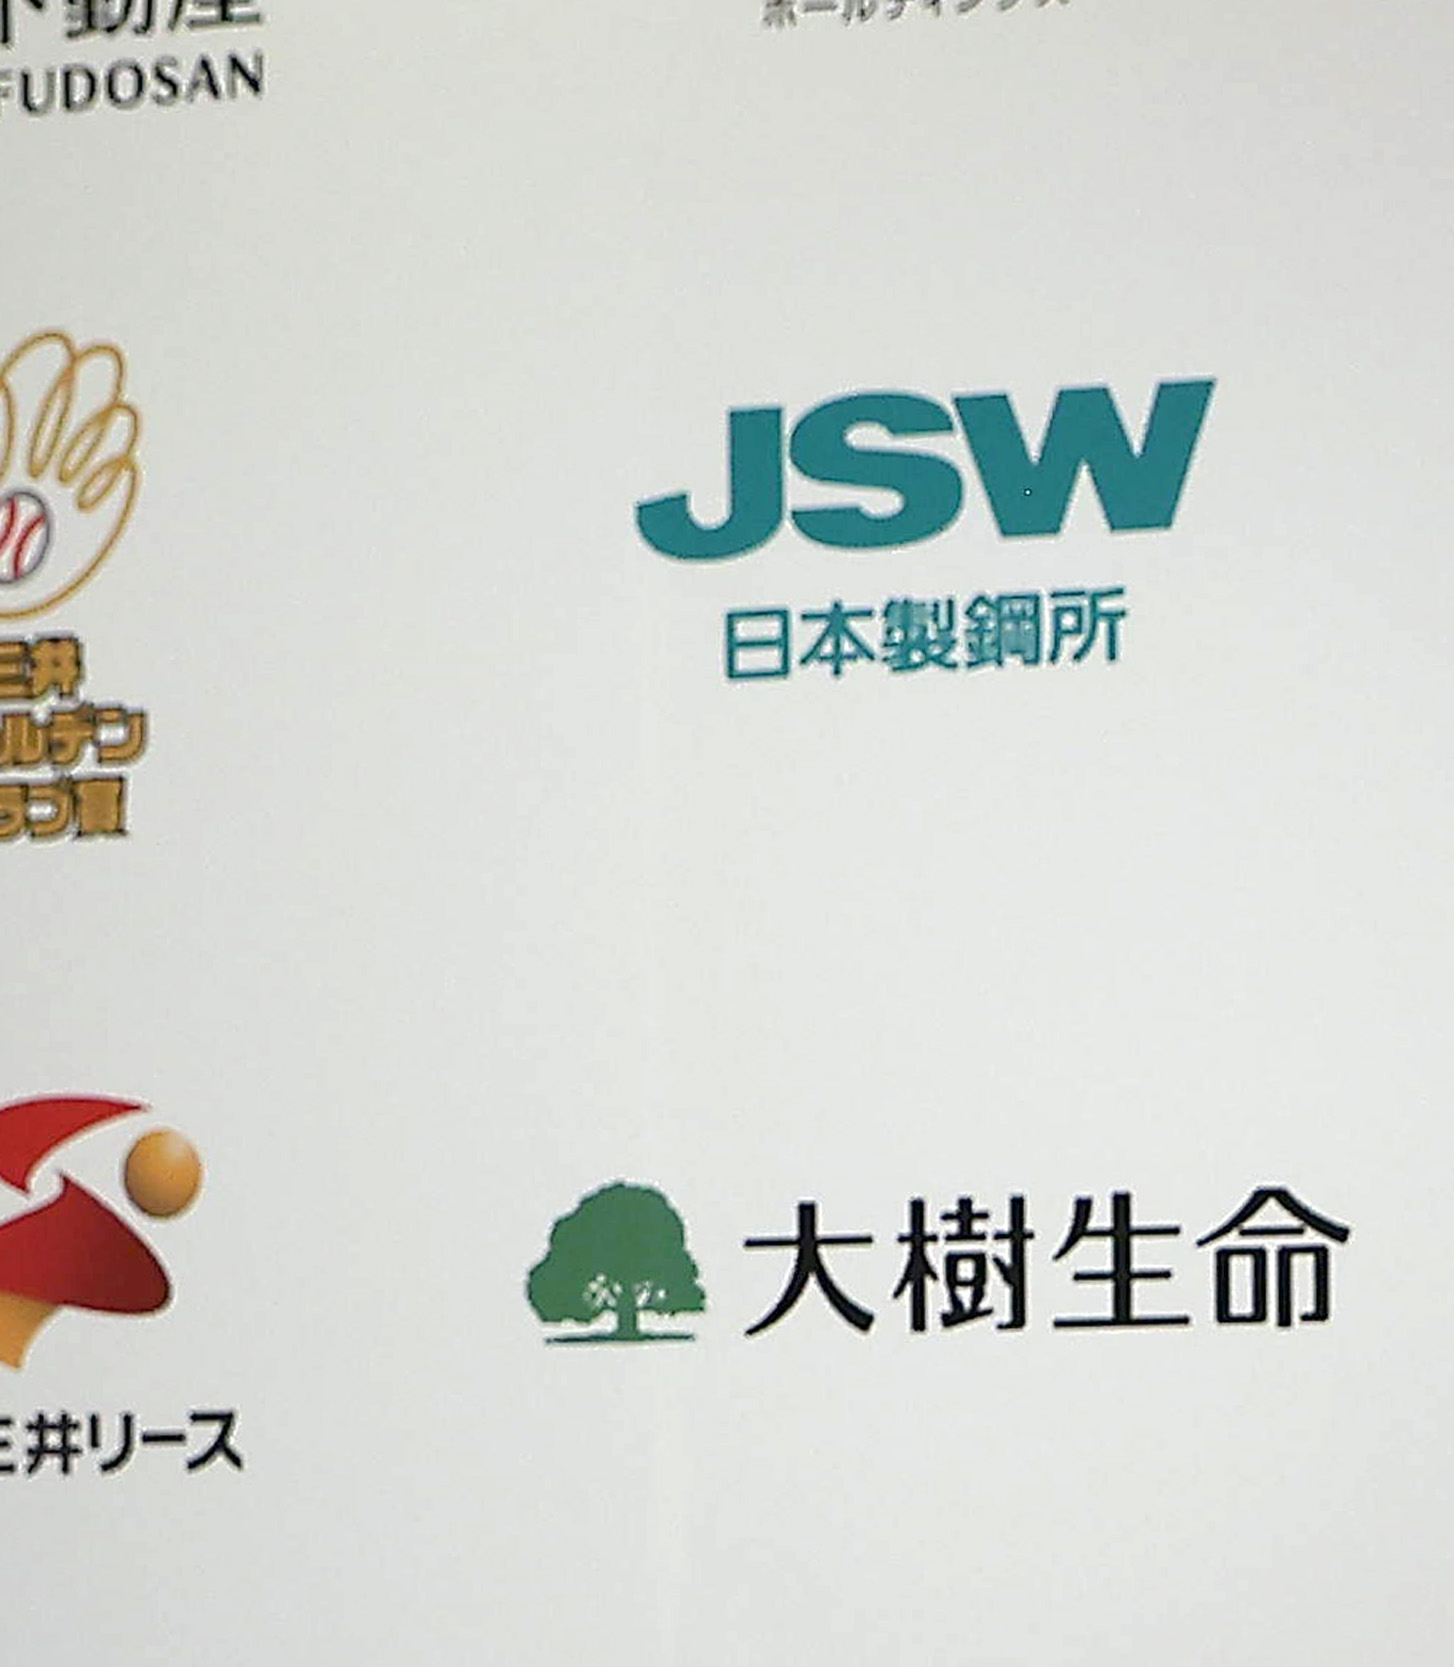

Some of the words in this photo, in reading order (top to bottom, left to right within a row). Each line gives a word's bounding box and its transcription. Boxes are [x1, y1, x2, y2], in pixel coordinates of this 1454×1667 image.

[634, 375, 1217, 561] JSW
[724, 586, 1128, 681] 日本製鋼所
[743, 1185, 1351, 1337] 大樹生命
[0, 1409, 243, 1476] 井リース
